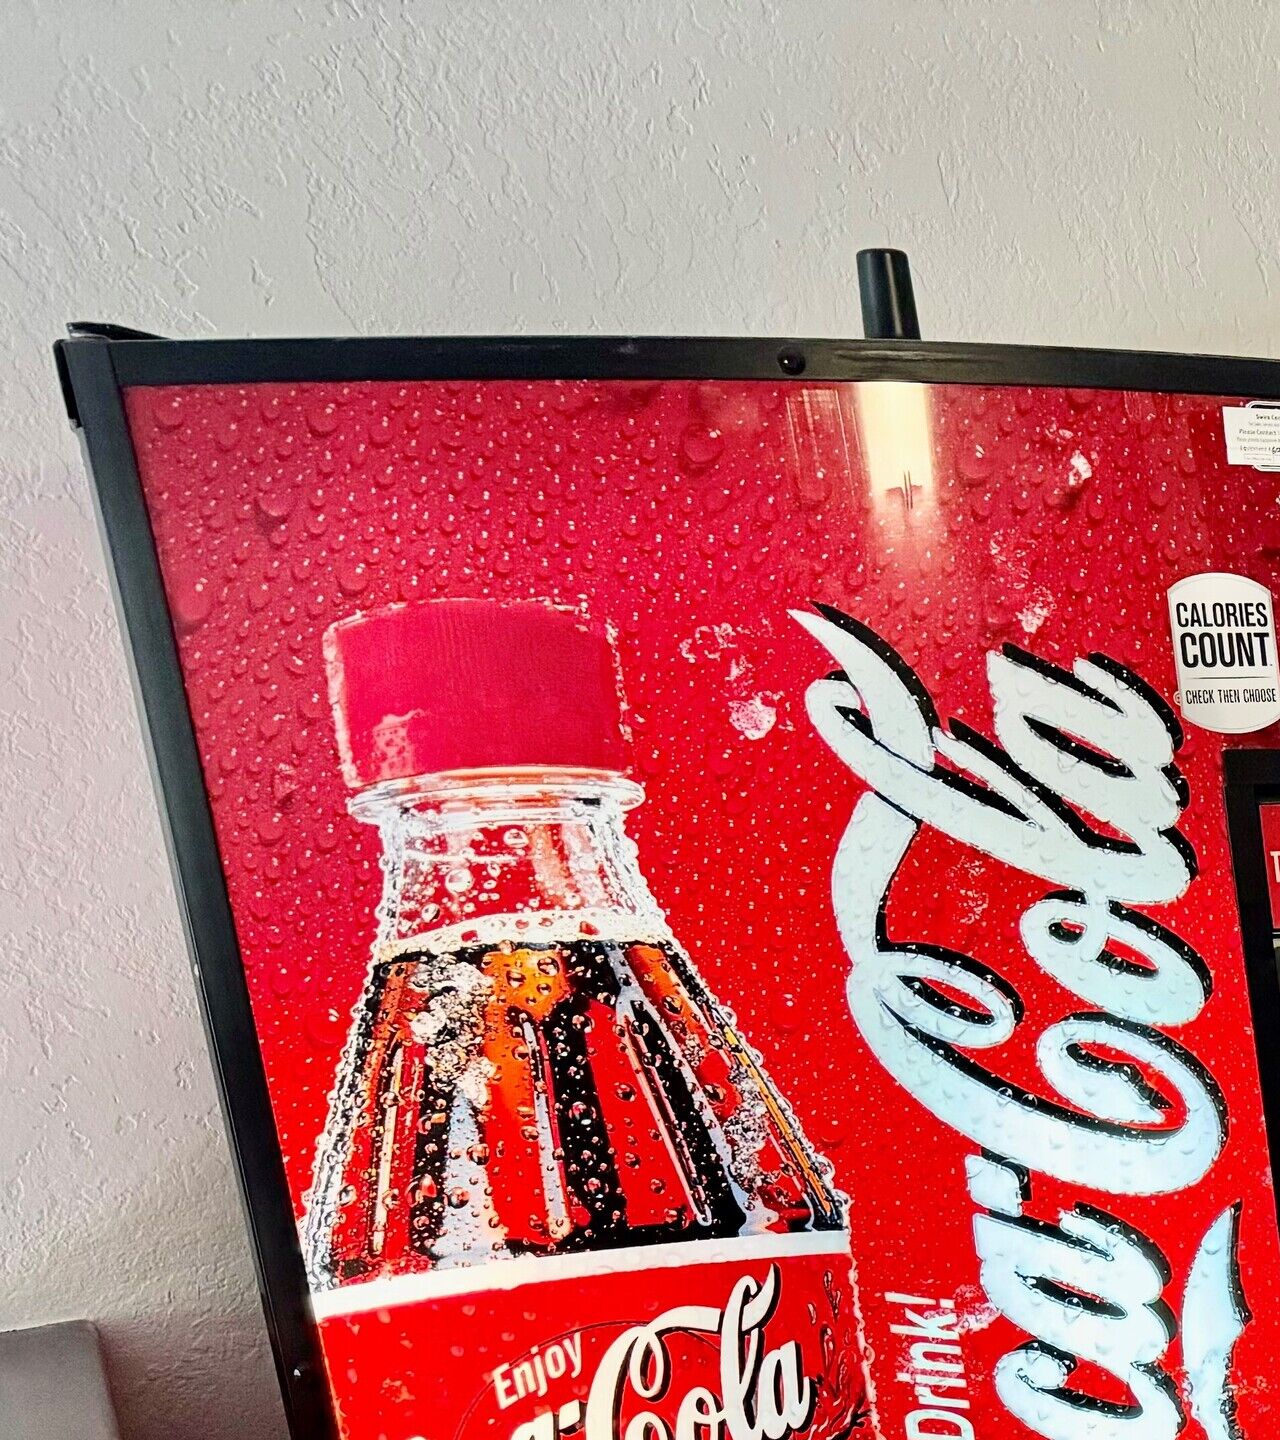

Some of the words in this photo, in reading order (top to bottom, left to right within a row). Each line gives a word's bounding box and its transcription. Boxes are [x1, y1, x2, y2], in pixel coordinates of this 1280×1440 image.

[1176, 602, 1268, 628] CALORIES
[1180, 632, 1270, 668] COUNT
[1185, 689, 1215, 704] CHECK
[1218, 689, 1240, 703] THEN
[1243, 688, 1277, 703] CHOOSE
[492, 1332, 584, 1410] Enjoy
